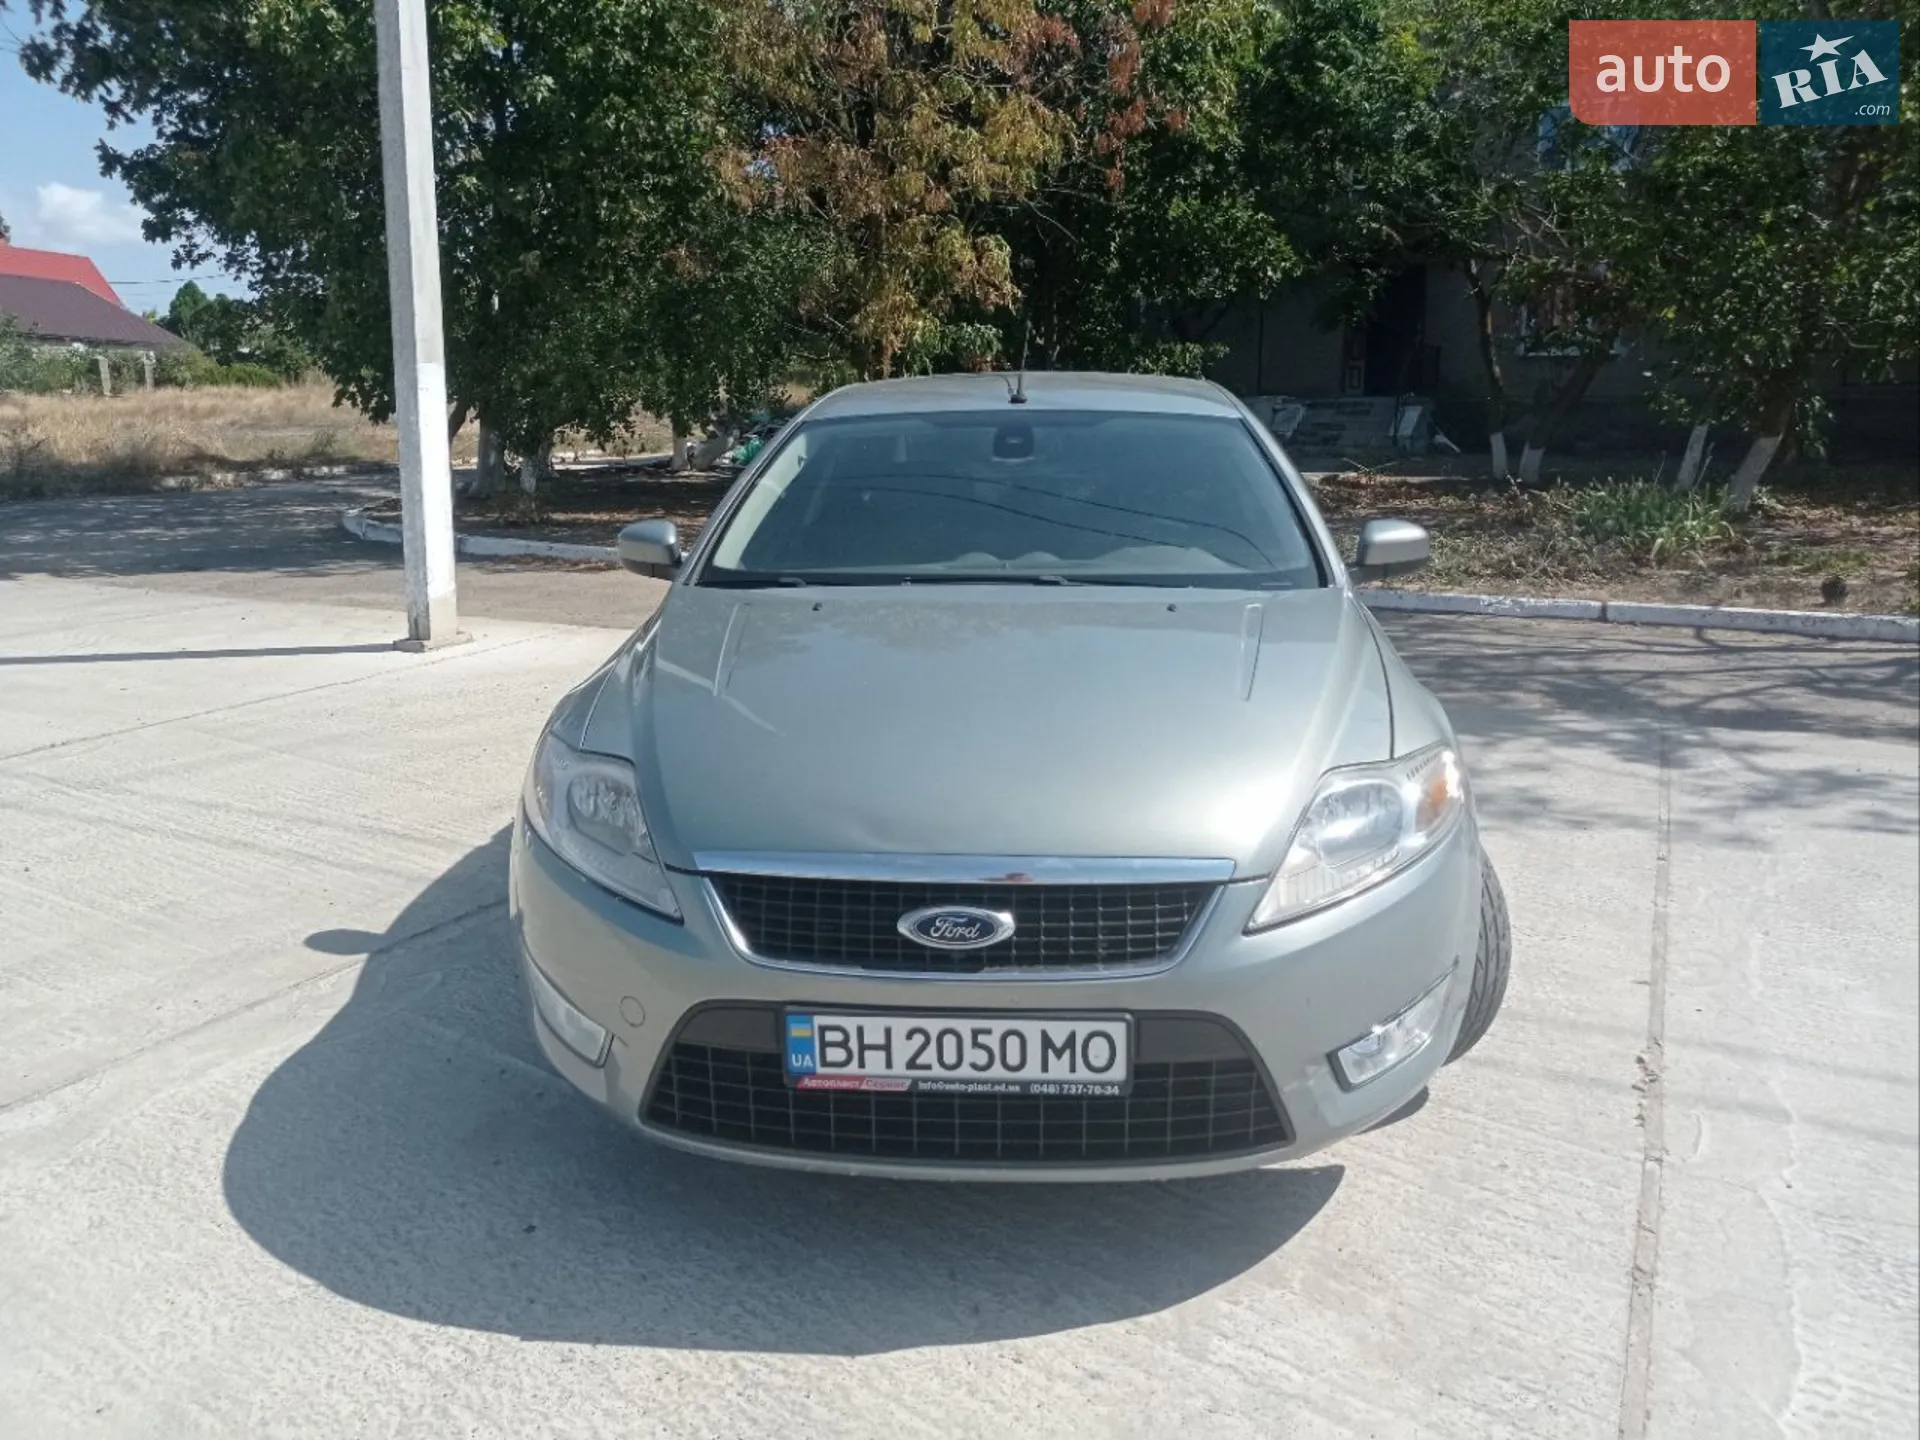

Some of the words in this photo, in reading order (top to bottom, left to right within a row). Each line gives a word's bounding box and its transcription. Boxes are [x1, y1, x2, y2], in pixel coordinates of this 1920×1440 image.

[930, 916, 980, 938] Ford
[818, 1024, 893, 1070] BH
[905, 1027, 1027, 1072] 2050
[1040, 1028, 1117, 1073] MO
[791, 1053, 814, 1068] UA
